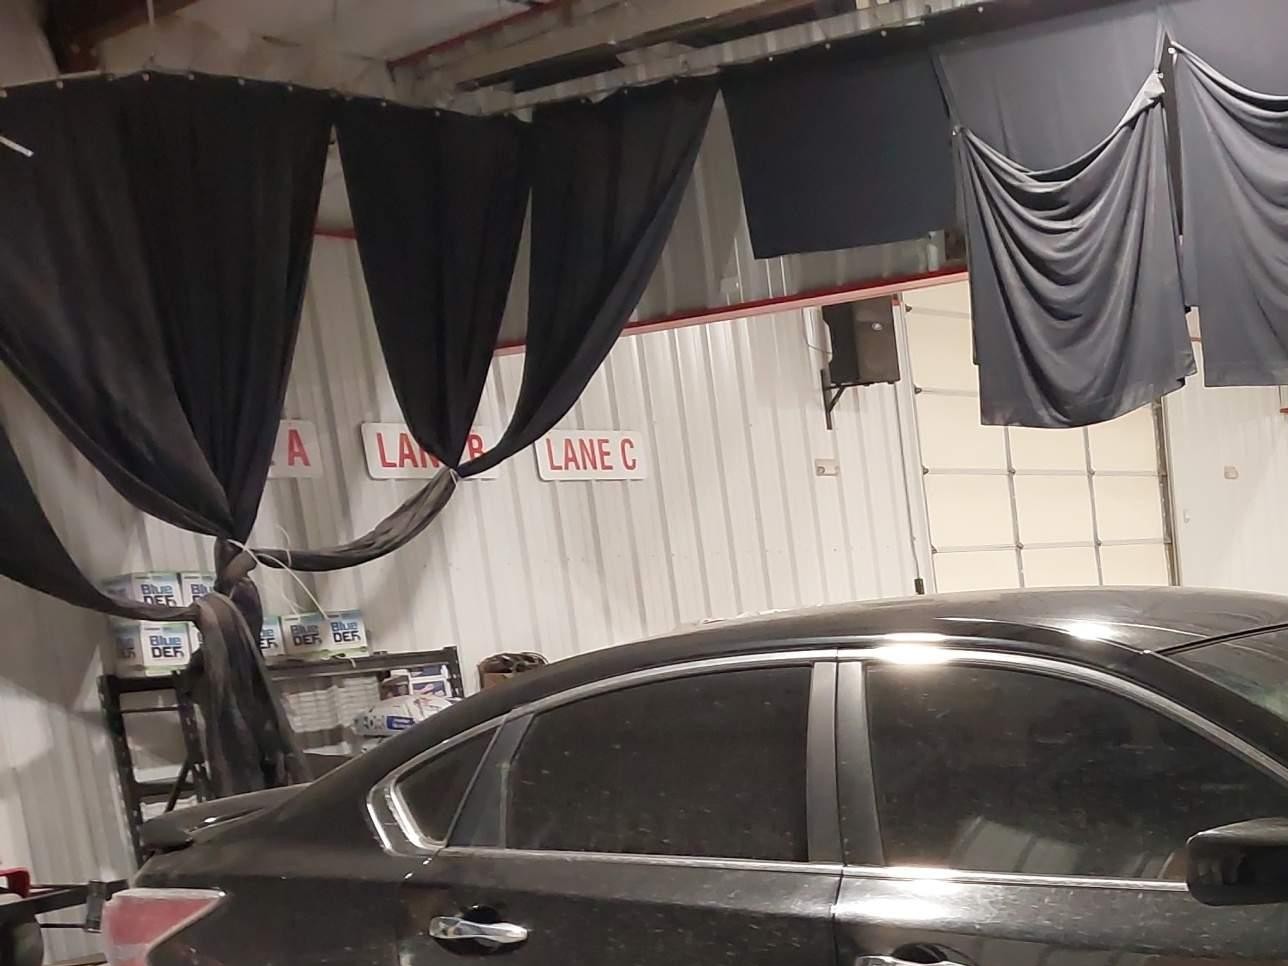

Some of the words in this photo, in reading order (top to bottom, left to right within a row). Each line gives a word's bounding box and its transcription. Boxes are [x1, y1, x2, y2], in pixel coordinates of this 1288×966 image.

[287, 429, 311, 466] A
[376, 433, 439, 468] LAN
[546, 438, 614, 470] LANE
[620, 438, 637, 470] C
[141, 584, 173, 594] Blue
[330, 621, 357, 632] Blue
[149, 635, 181, 646] Blue
[332, 631, 361, 643] DEF
[151, 647, 184, 658] DEF
